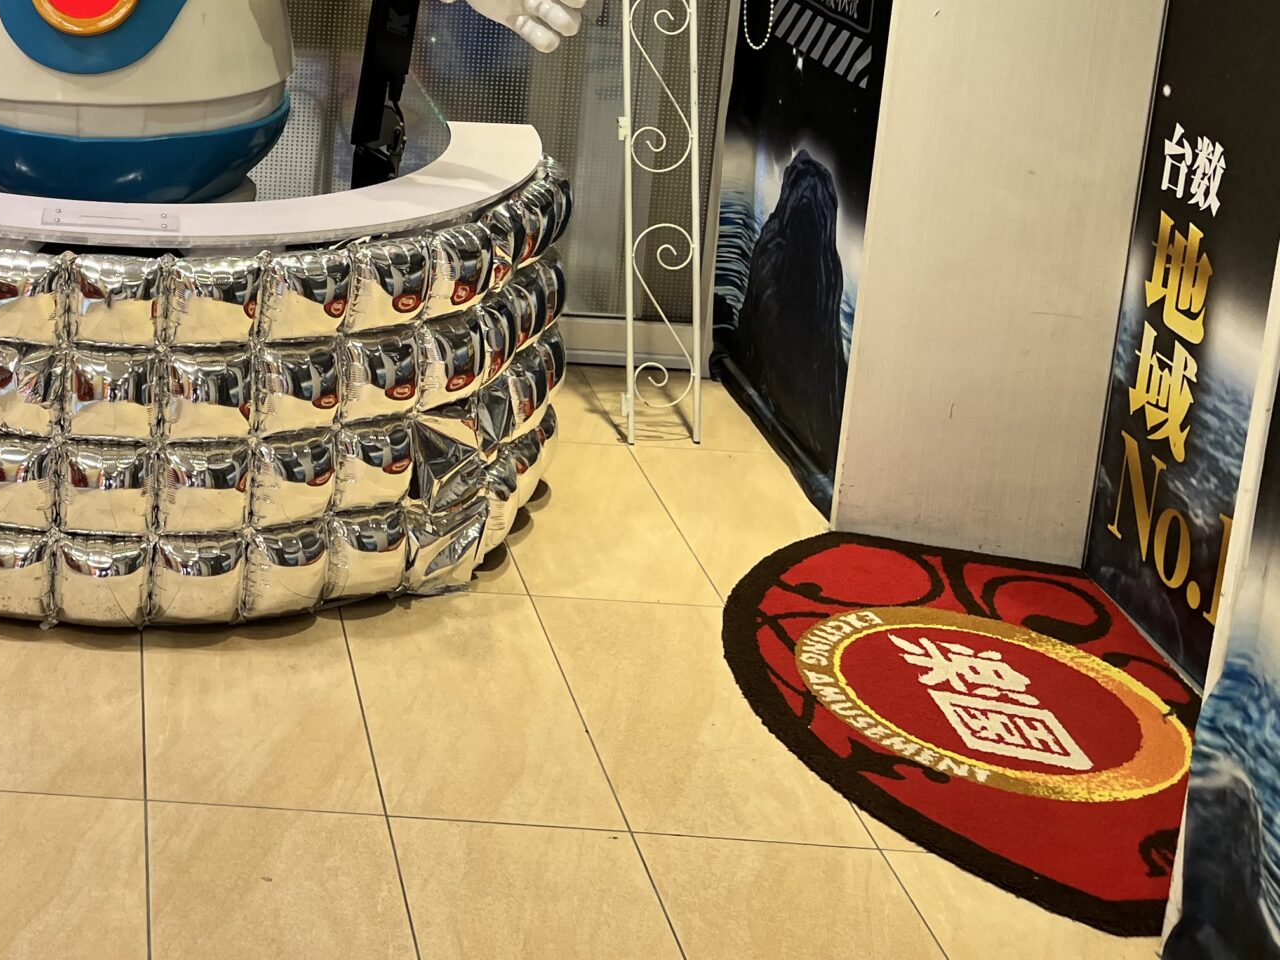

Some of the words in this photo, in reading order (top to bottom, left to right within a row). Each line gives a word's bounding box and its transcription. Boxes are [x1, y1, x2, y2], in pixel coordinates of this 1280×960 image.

[1160, 122, 1227, 217] 台数
[1129, 209, 1214, 463] 地域
[799, 611, 884, 667] EXCITING
[803, 668, 991, 783] AMUSEMENT
[887, 633, 1094, 771] 楽園
